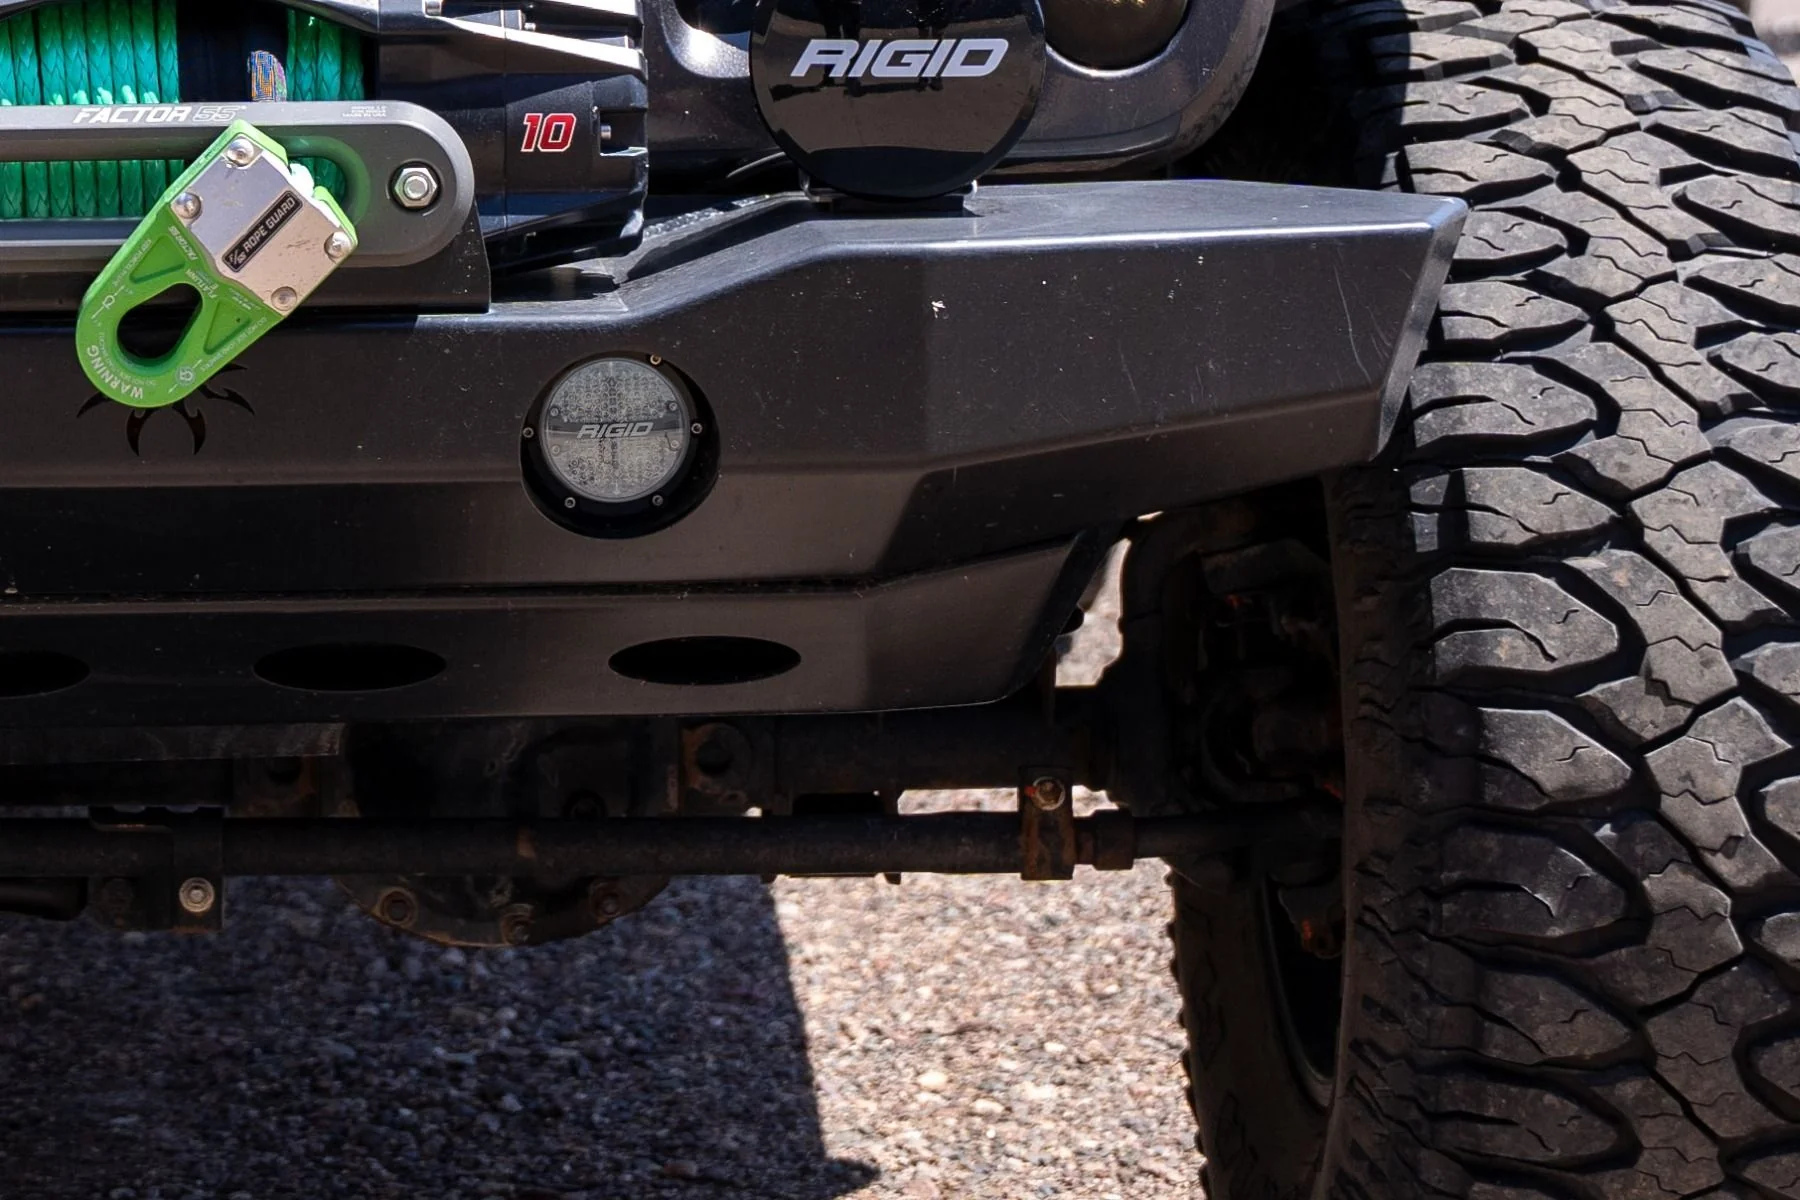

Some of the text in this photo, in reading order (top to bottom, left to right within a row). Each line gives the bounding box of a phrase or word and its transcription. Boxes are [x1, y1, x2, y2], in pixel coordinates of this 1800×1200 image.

[790, 38, 1009, 77] RIGID
[73, 106, 191, 124] FACTOR
[520, 113, 577, 152] 10
[243, 225, 268, 253] ROPE
[265, 197, 296, 229] GUARD
[87, 344, 144, 400] WARNING
[576, 422, 654, 439] RIGID
